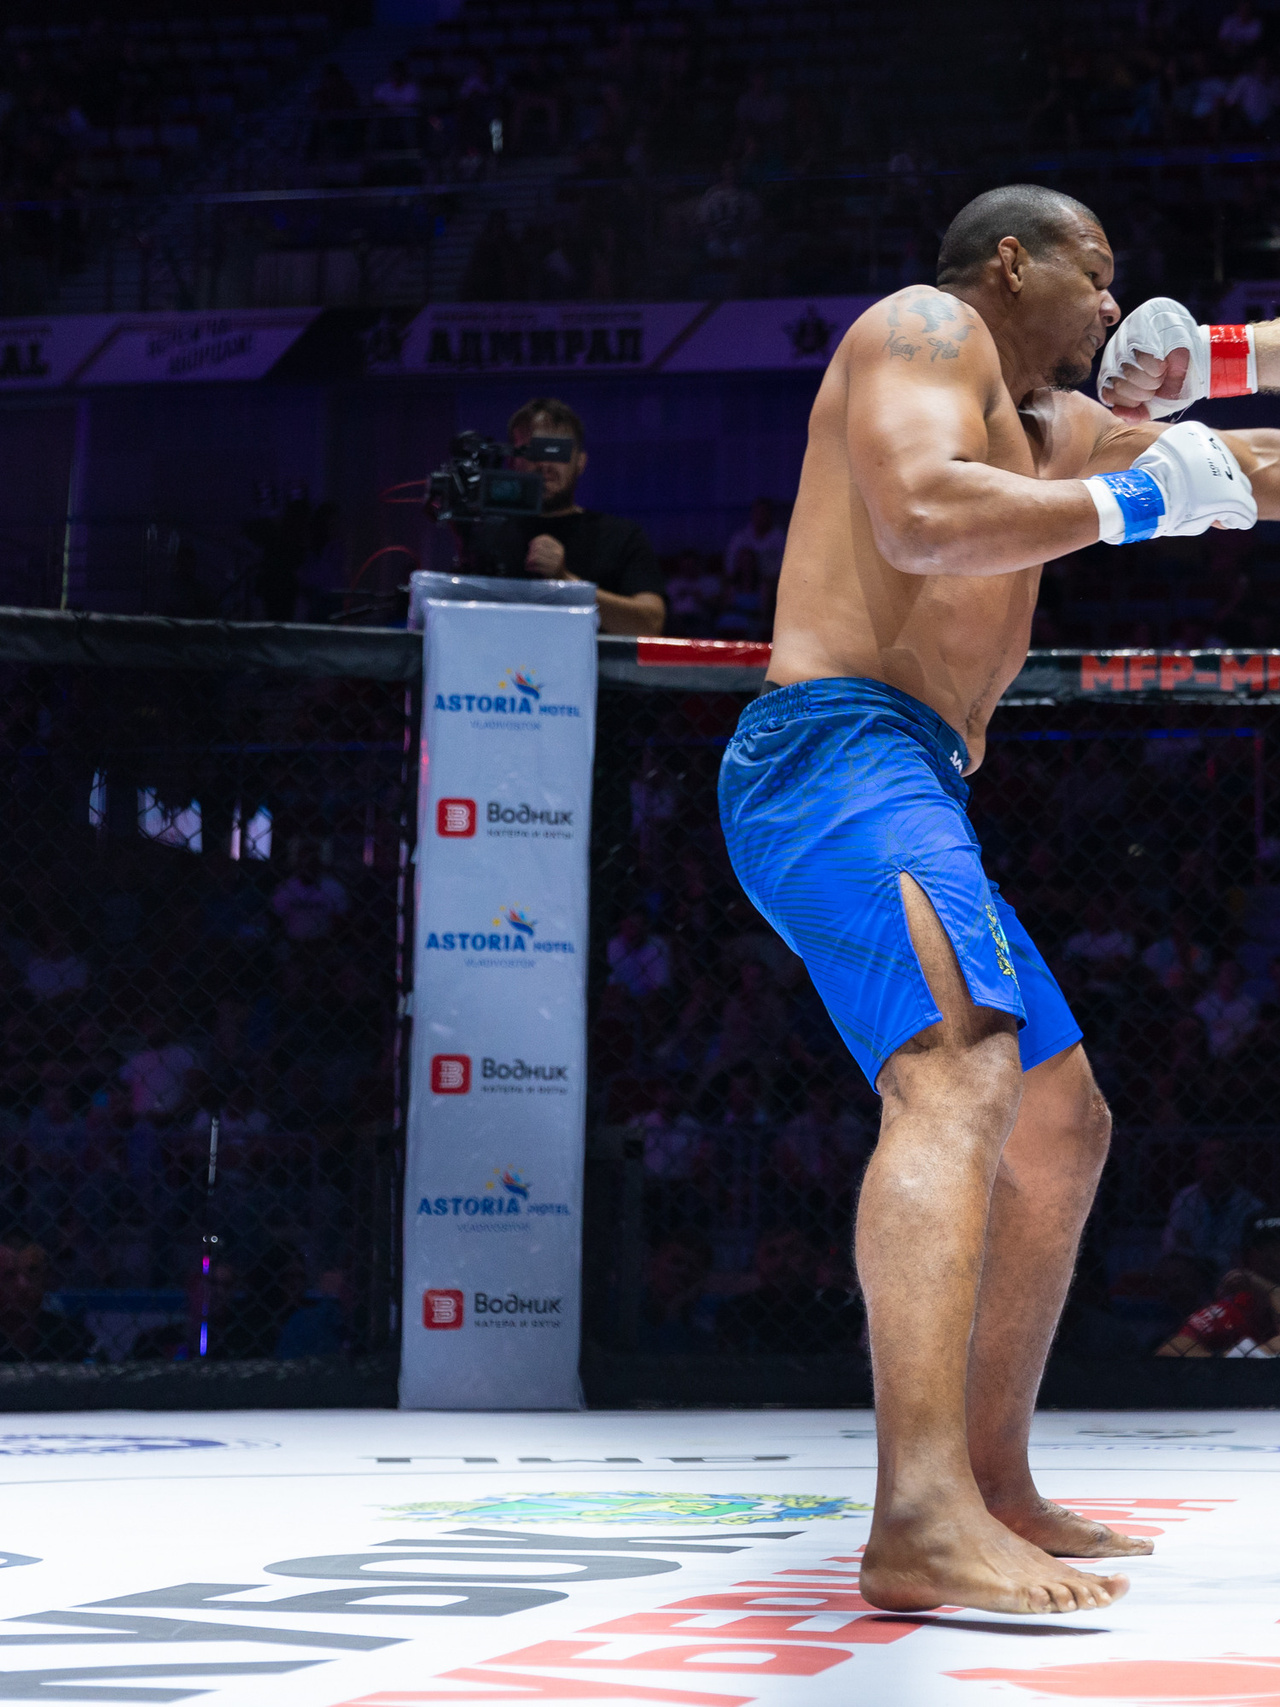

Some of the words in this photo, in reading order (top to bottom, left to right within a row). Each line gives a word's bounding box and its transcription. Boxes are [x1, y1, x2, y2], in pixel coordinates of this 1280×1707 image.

[425, 329, 644, 365] АДМИРАЛ
[434, 694, 532, 714] ASTORIA
[538, 704, 581, 717] HOTEL
[487, 801, 574, 825] Водник
[425, 933, 526, 952] ASTORIA
[482, 1057, 568, 1081] Водник
[417, 1197, 519, 1216] ASTORIA
[474, 1292, 561, 1314] Водник
